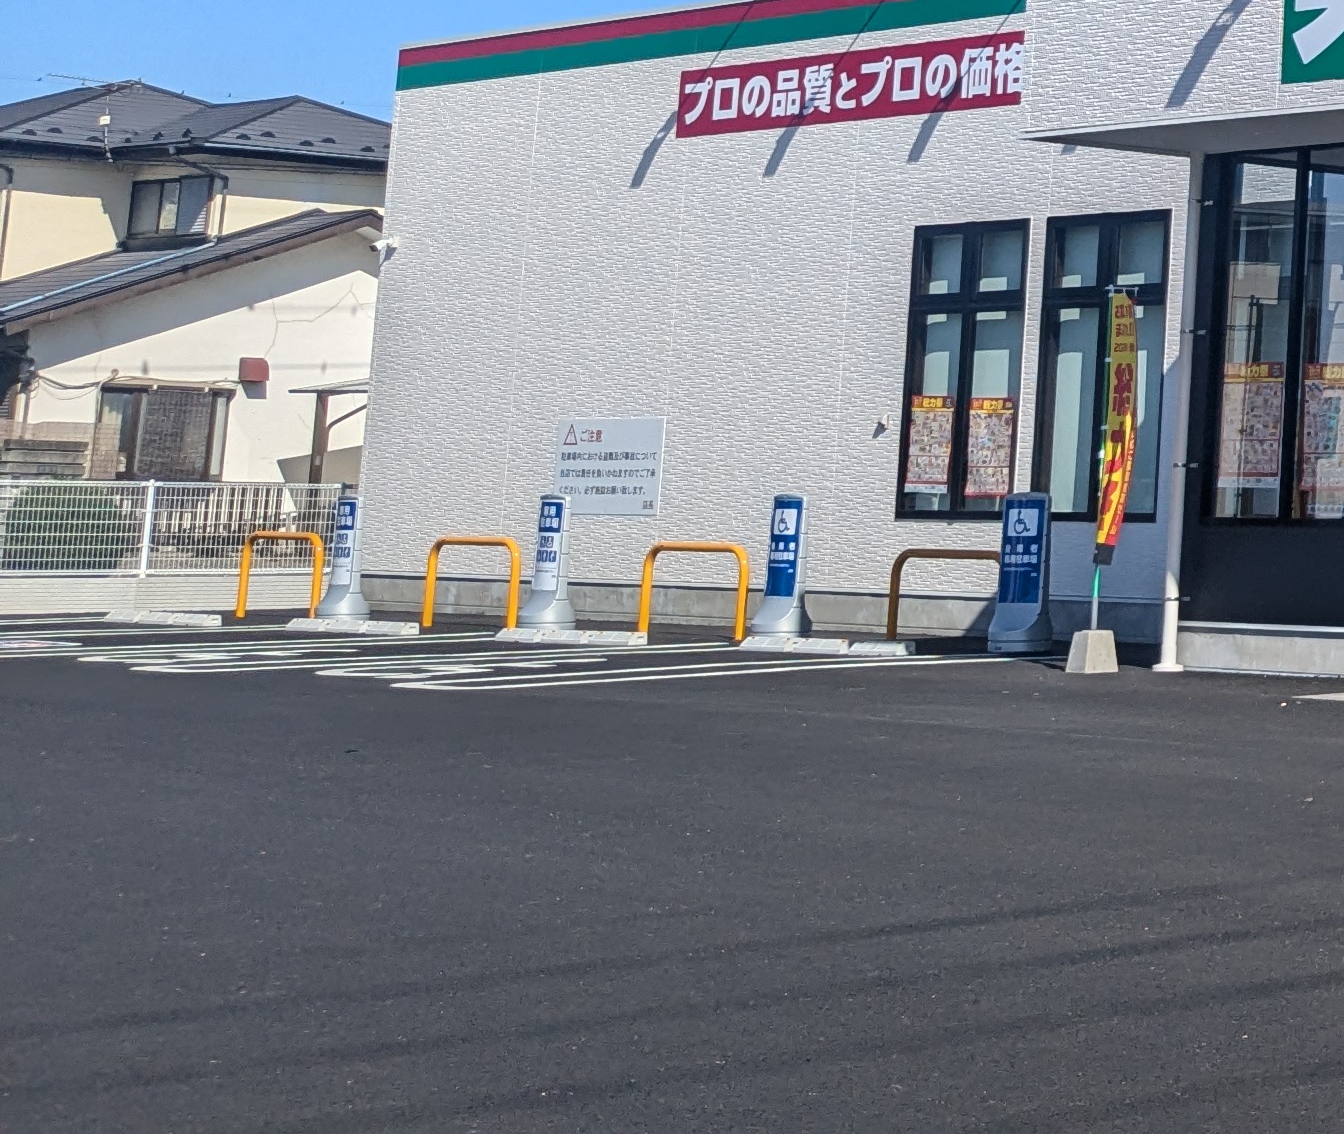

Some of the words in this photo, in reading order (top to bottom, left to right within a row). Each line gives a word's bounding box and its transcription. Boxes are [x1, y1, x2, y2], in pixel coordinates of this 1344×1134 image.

[684, 42, 1024, 126] プロの品質とプロの価格
